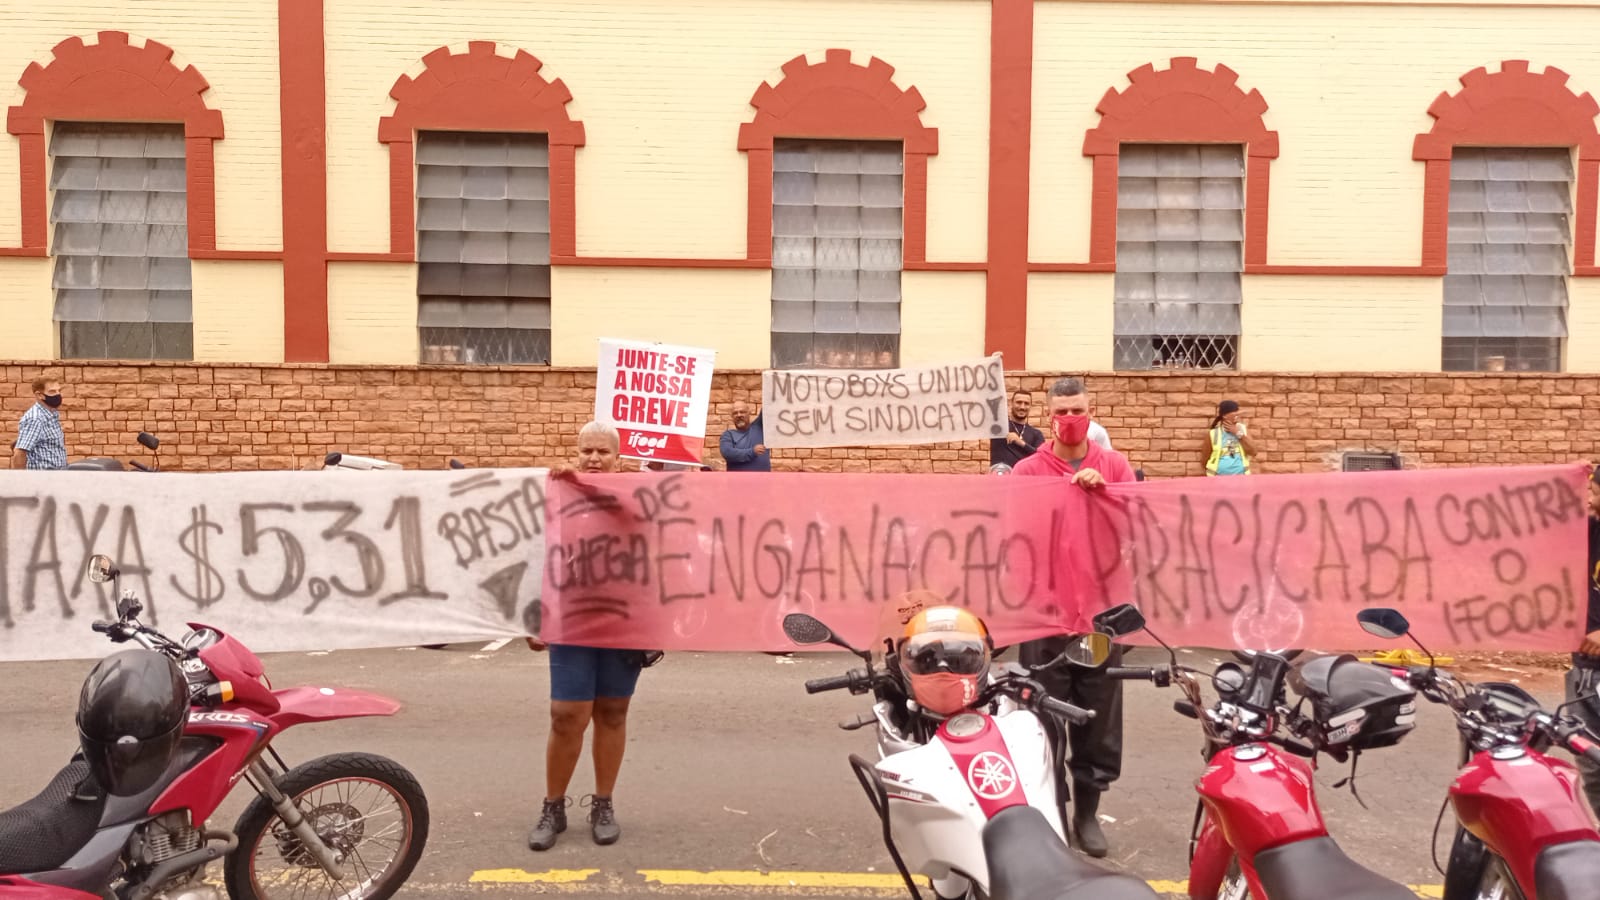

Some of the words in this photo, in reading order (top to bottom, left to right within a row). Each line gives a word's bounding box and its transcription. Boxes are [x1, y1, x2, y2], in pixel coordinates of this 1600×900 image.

[616, 349, 697, 376] JUNTE-SE
[771, 372, 910, 404] MOTOBOYS
[919, 362, 999, 393] UNIDOS
[614, 370, 627, 390] A
[631, 371, 692, 398] NOSSA
[612, 394, 690, 428] GREVE
[776, 406, 836, 436] SEM
[845, 395, 1003, 434] SINDICATO!
[627, 432, 669, 449] ifood
[438, 477, 548, 570] BASTA
[1435, 477, 1585, 546] CONTRA
[548, 533, 650, 592] CHEGA
[632, 474, 691, 522] DE
[0, 496, 158, 628] TAXA
[1491, 548, 1527, 585] O
